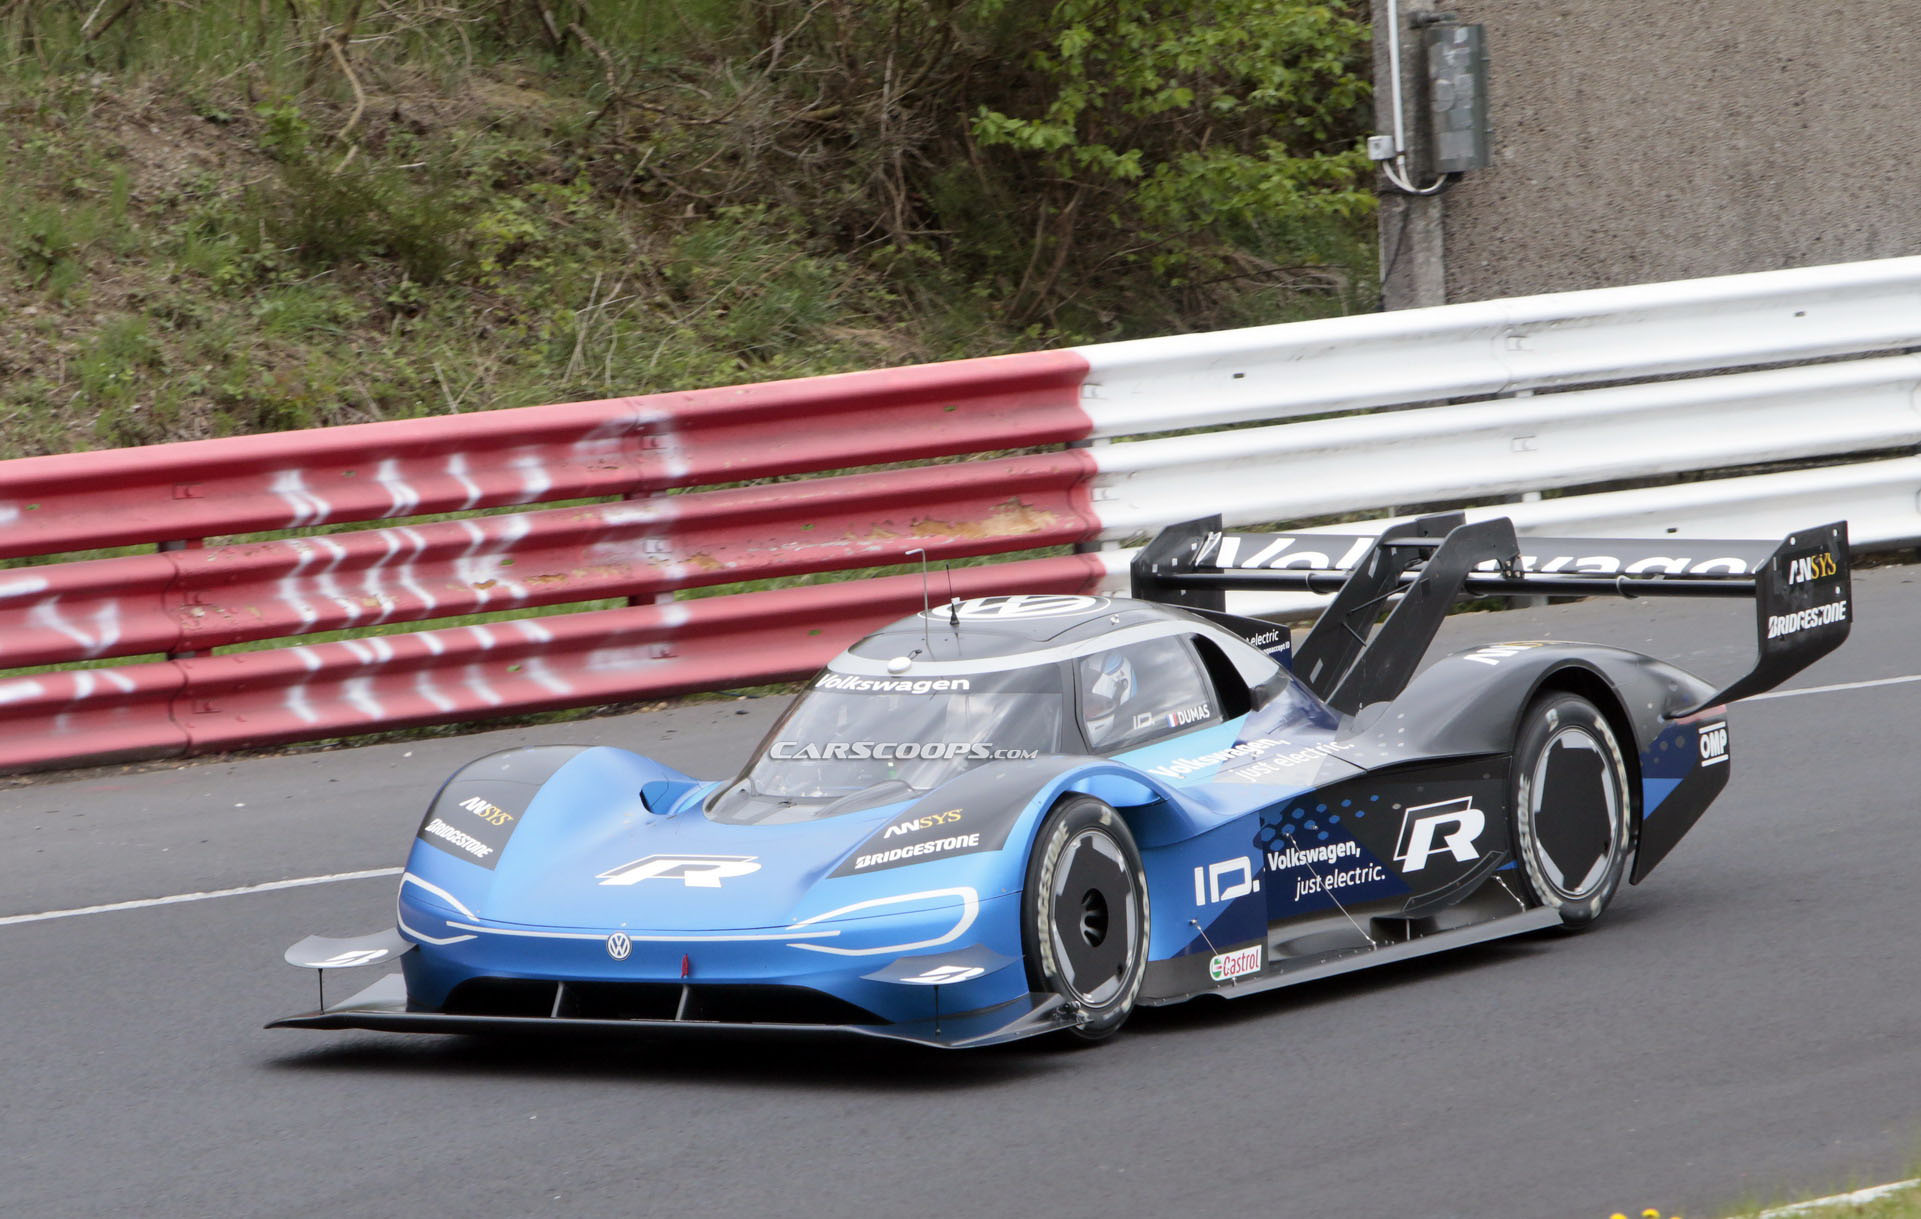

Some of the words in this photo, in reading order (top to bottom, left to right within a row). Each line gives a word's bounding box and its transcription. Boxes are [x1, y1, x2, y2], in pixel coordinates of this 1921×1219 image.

[1788, 553, 1837, 585] ANSYS
[1767, 600, 1847, 639] BRIDGESTONE
[815, 674, 970, 694] Volkswagen
[1177, 704, 1210, 725] DUMAS
[1700, 728, 1728, 759] OMP
[459, 796, 514, 826] ANSYS
[884, 808, 963, 839] ANSYS
[425, 818, 494, 858] BRIDGESTONE
[1393, 796, 1486, 873] R
[854, 833, 980, 870] BRIDGESTONE
[1267, 840, 1361, 872] Volkswagen,
[1194, 856, 1260, 906] ID.
[1295, 874, 1322, 901] just
[1324, 864, 1386, 890] electric.
[1223, 949, 1259, 977] Castrol
